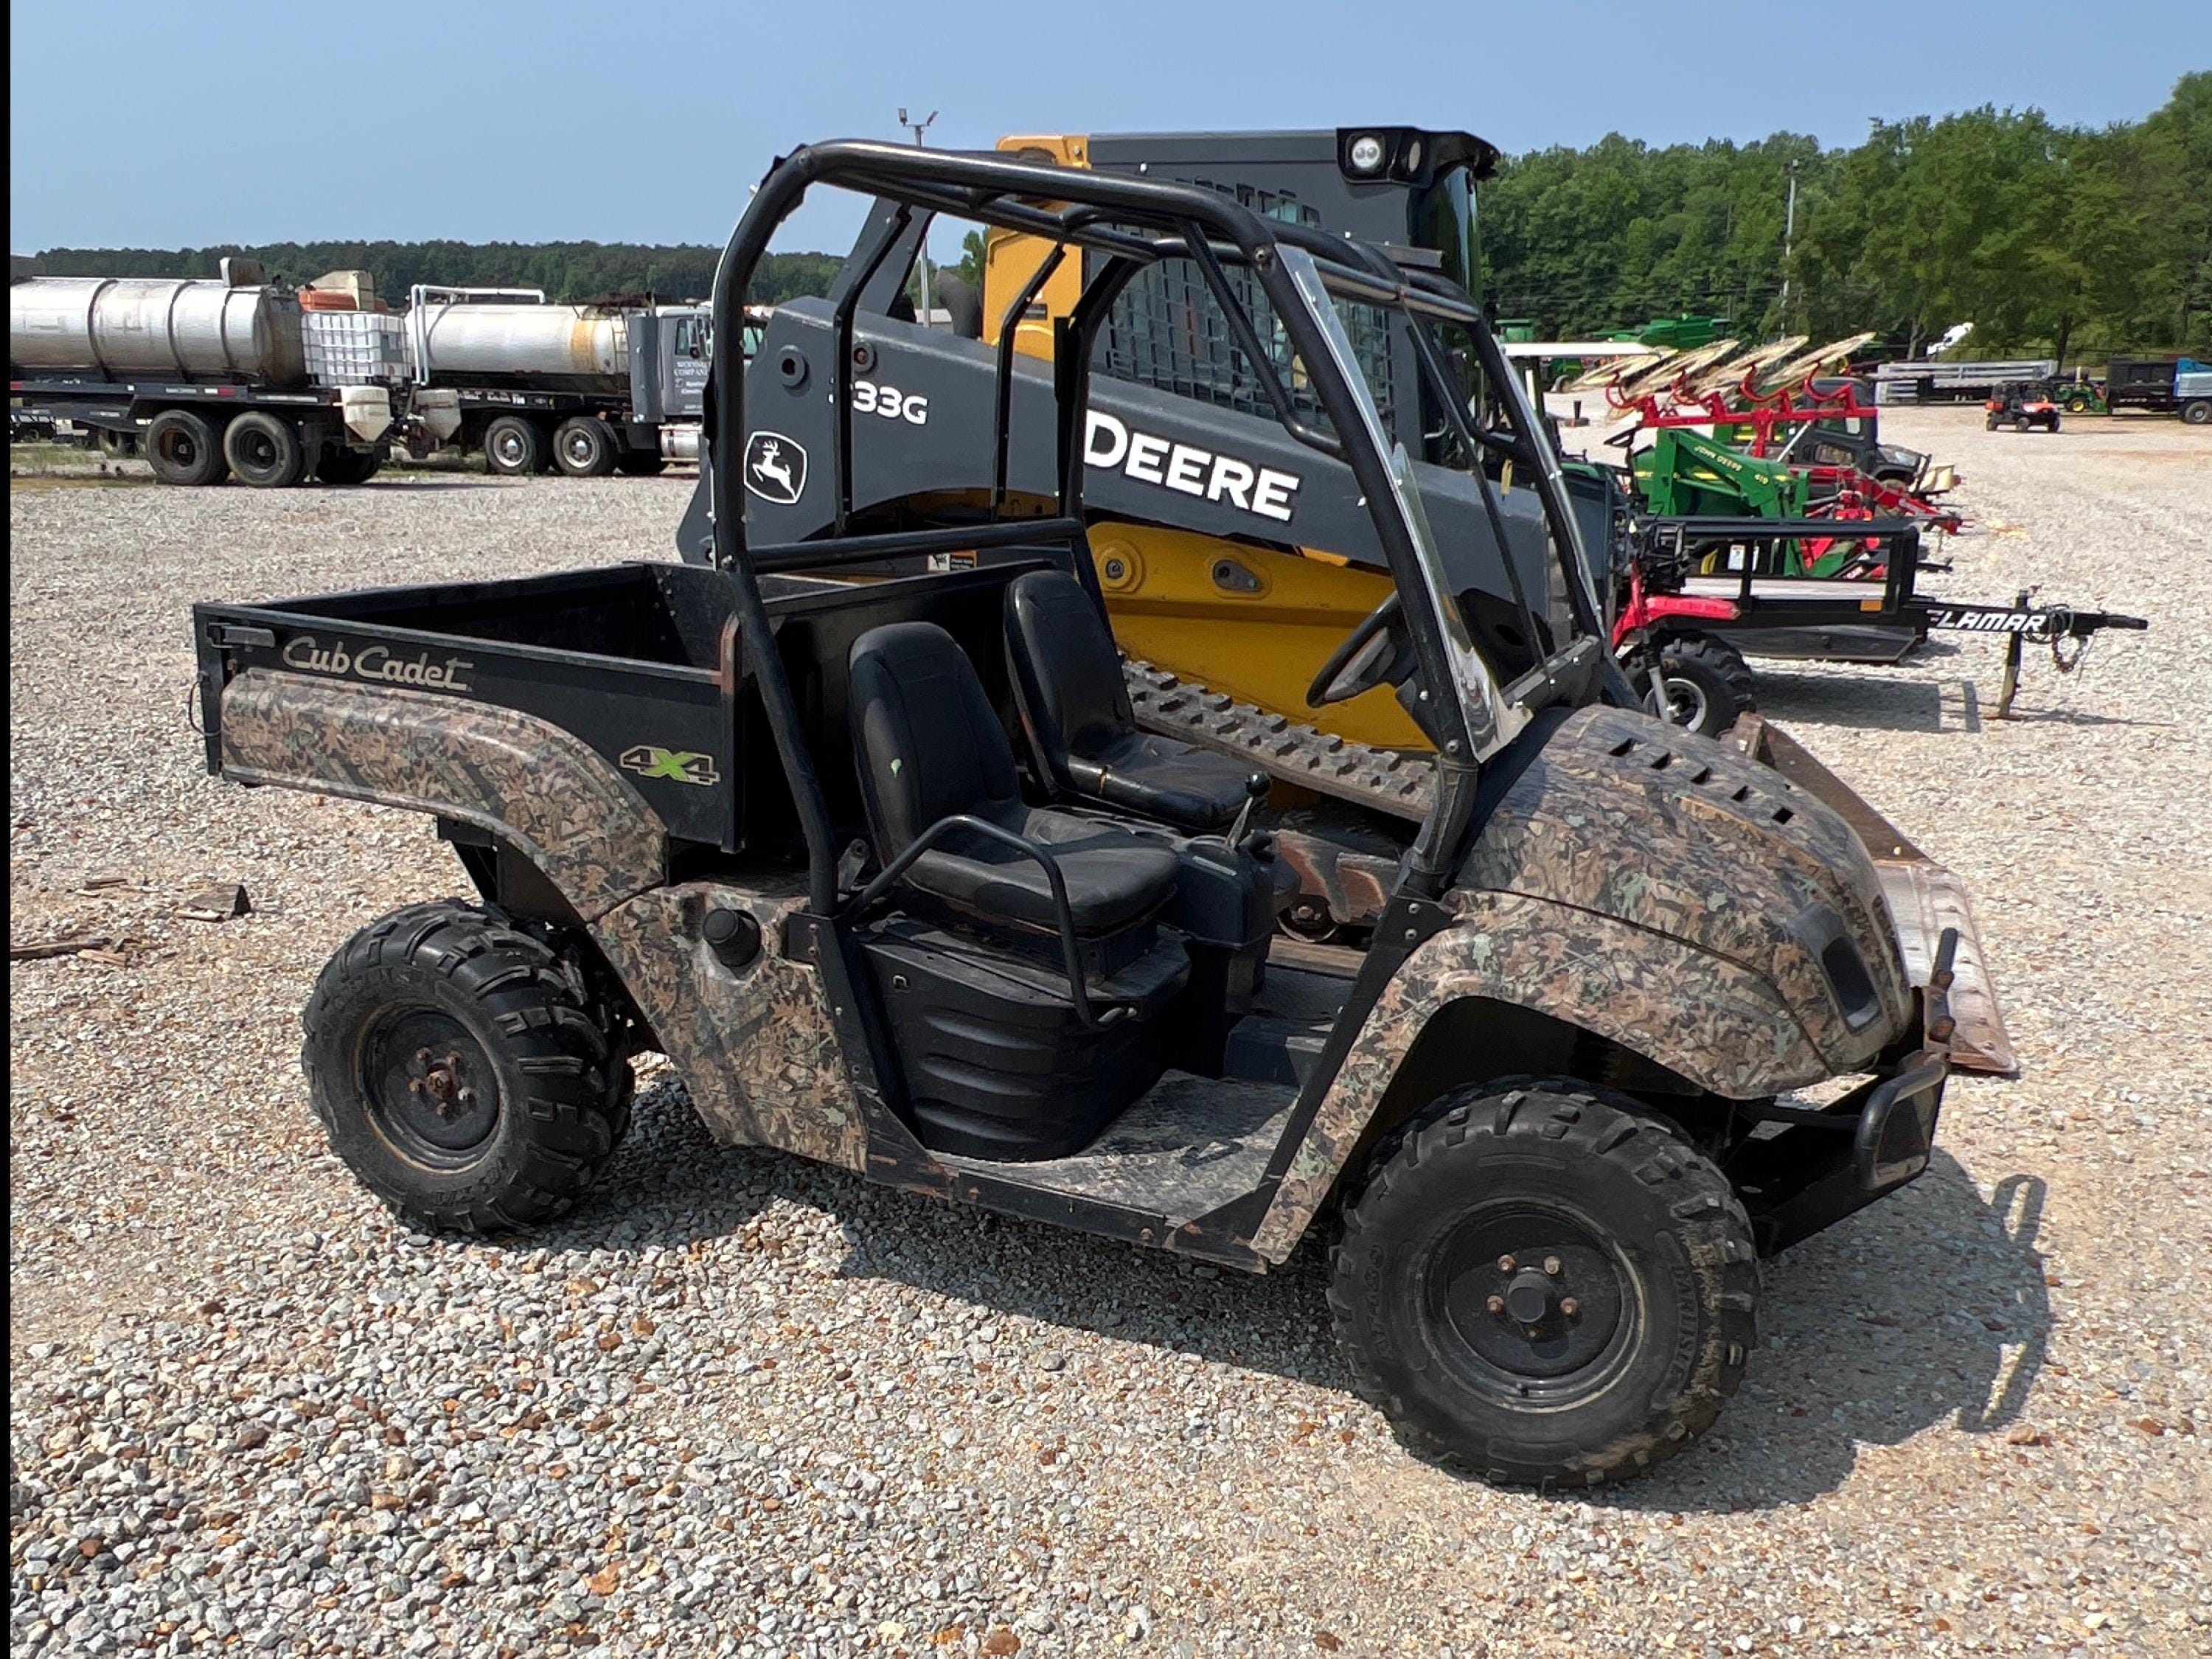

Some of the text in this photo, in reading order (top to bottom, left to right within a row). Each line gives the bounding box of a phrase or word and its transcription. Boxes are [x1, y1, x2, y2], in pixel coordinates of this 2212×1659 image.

[849, 380, 928, 425] 33G
[1082, 409, 1301, 521] DEERE
[283, 636, 473, 691] Cub Cadet
